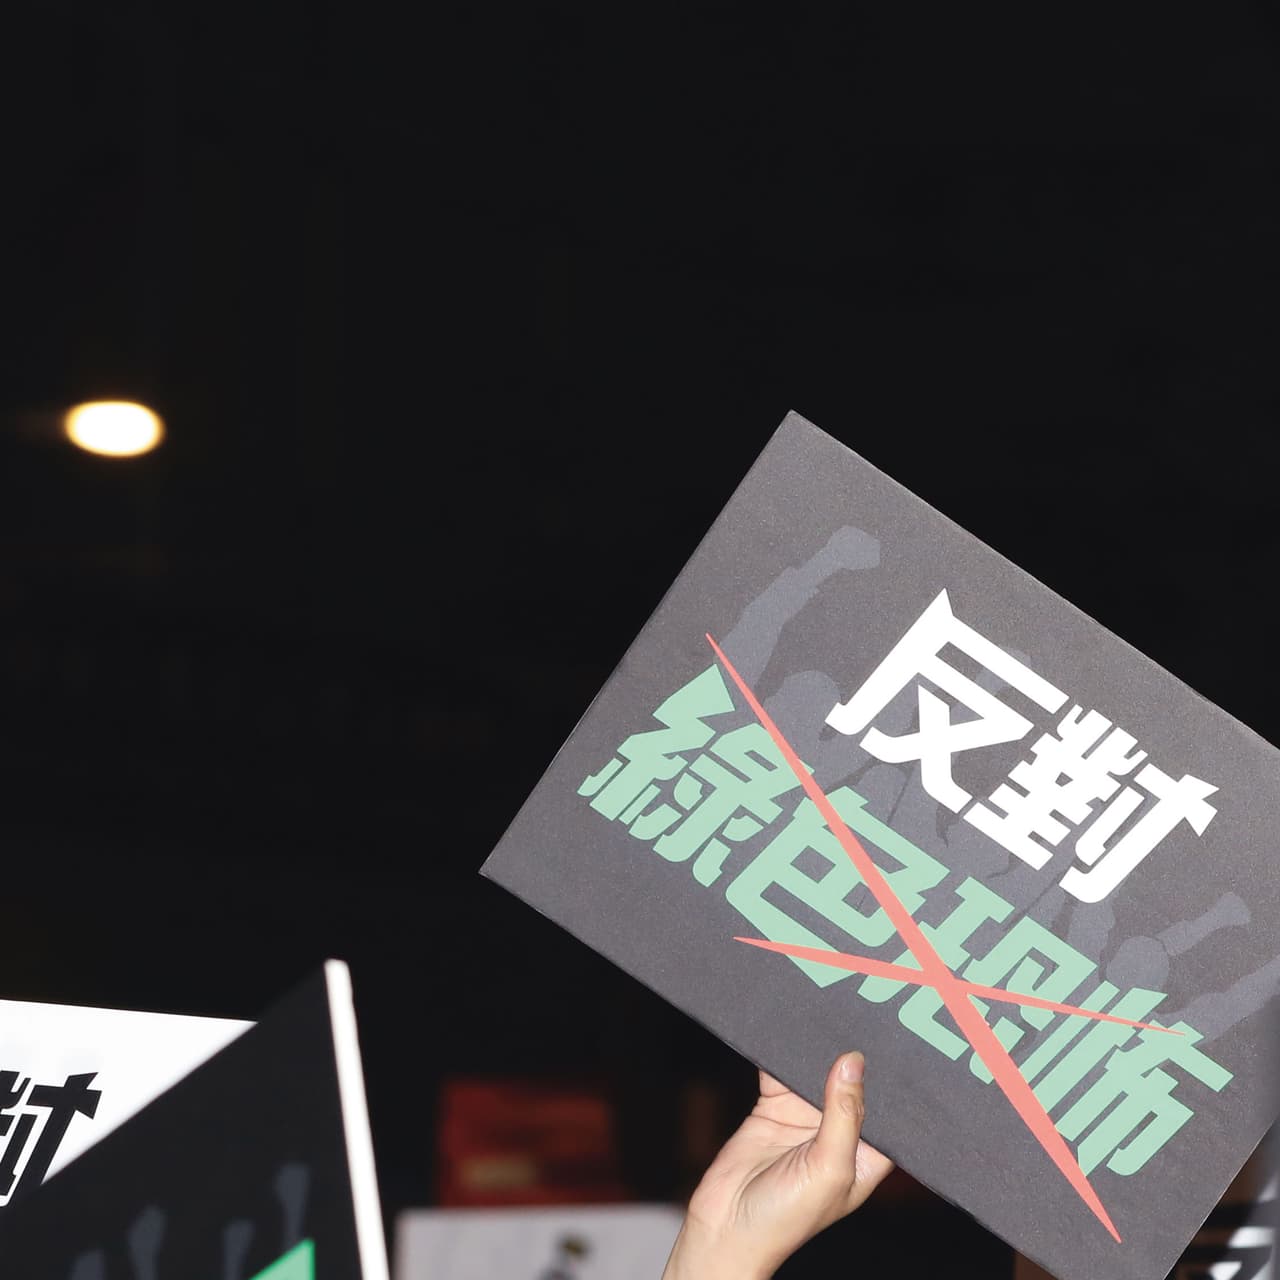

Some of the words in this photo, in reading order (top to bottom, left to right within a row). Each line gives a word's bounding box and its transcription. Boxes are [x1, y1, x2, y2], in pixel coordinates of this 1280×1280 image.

[577, 662, 1236, 1177] 綠色恐怖
[824, 588, 1219, 902] 反對
